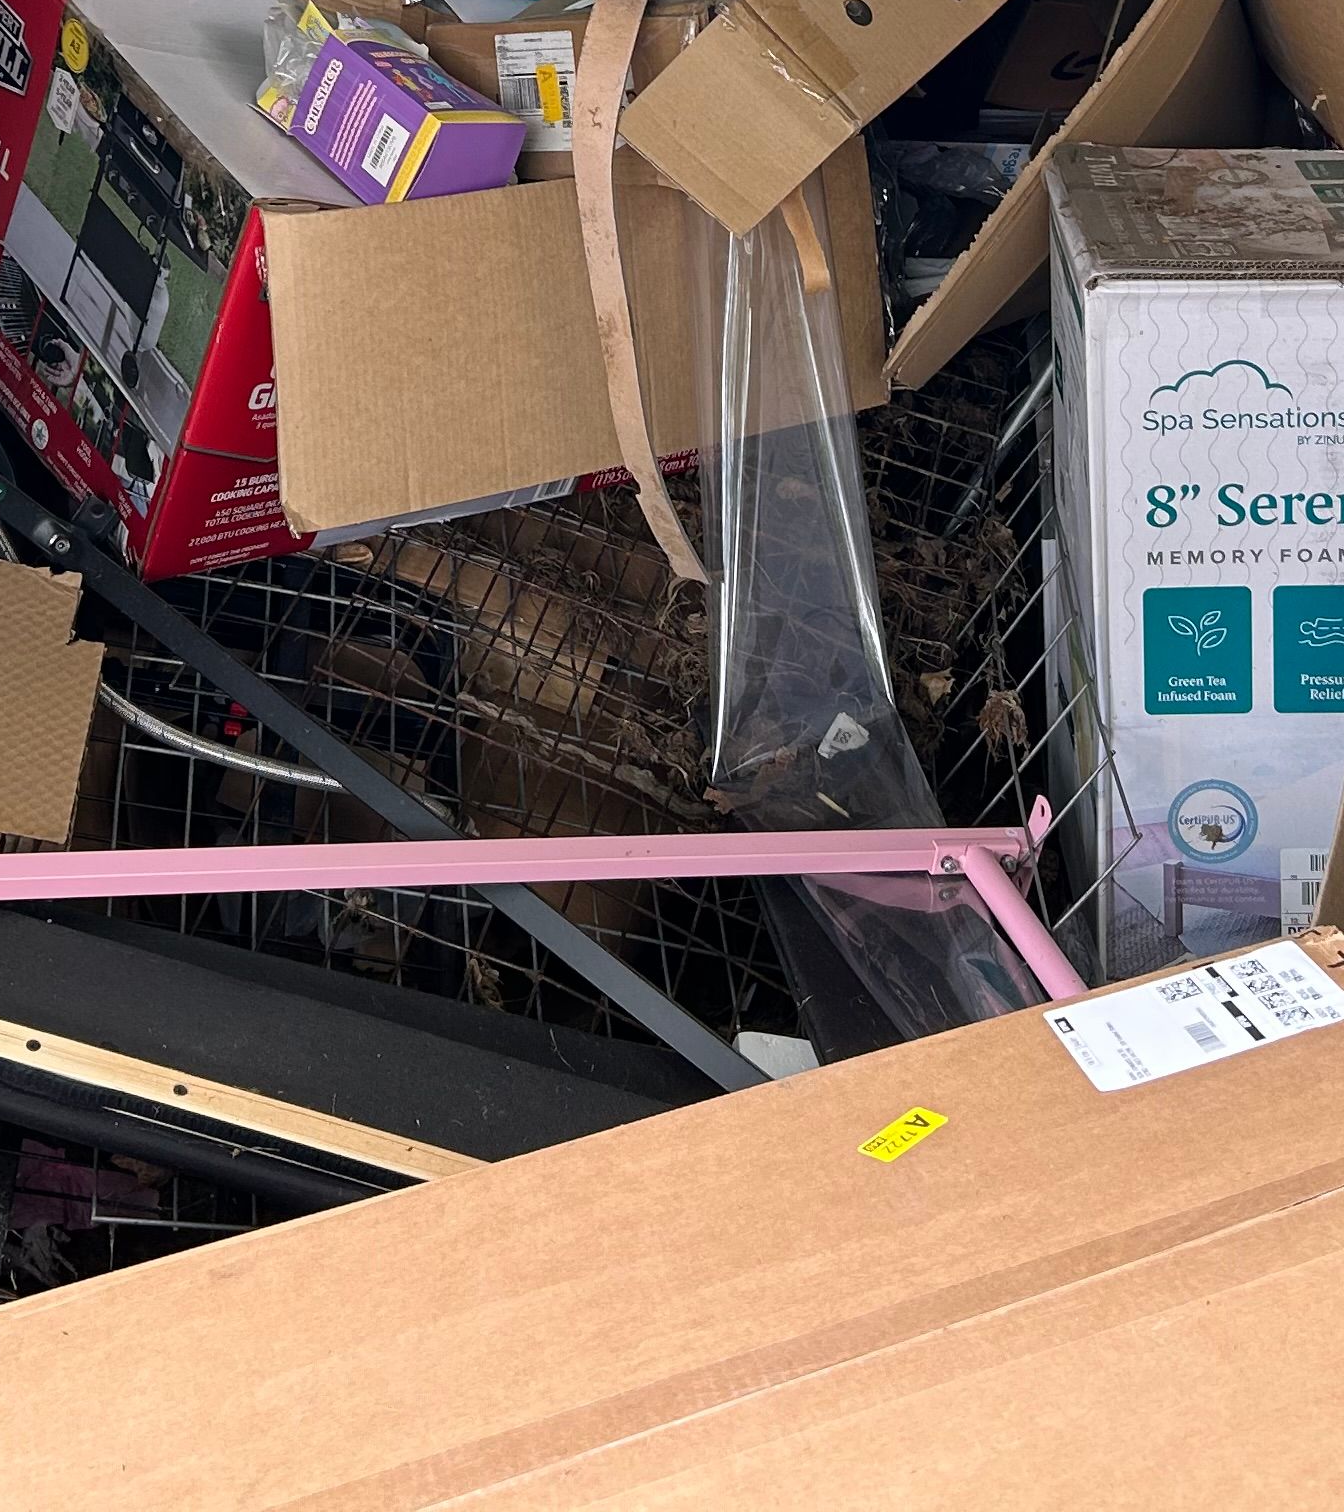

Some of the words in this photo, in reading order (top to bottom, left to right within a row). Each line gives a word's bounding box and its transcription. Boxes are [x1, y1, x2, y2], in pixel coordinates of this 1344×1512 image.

[1142, 409, 1194, 436] Spa
[1297, 435, 1311, 446] BY
[211, 487, 254, 503] COOKING
[204, 515, 230, 528] TOTAL
[217, 529, 235, 542] BTU
[234, 522, 270, 537] COOKING
[1146, 549, 1264, 565] MEMORY
[1168, 676, 1204, 688] Green
[1206, 676, 1227, 687] Tea
[1157, 691, 1202, 702] Infused
[1204, 691, 1237, 702] Foam
[904, 1113, 931, 1128] A
